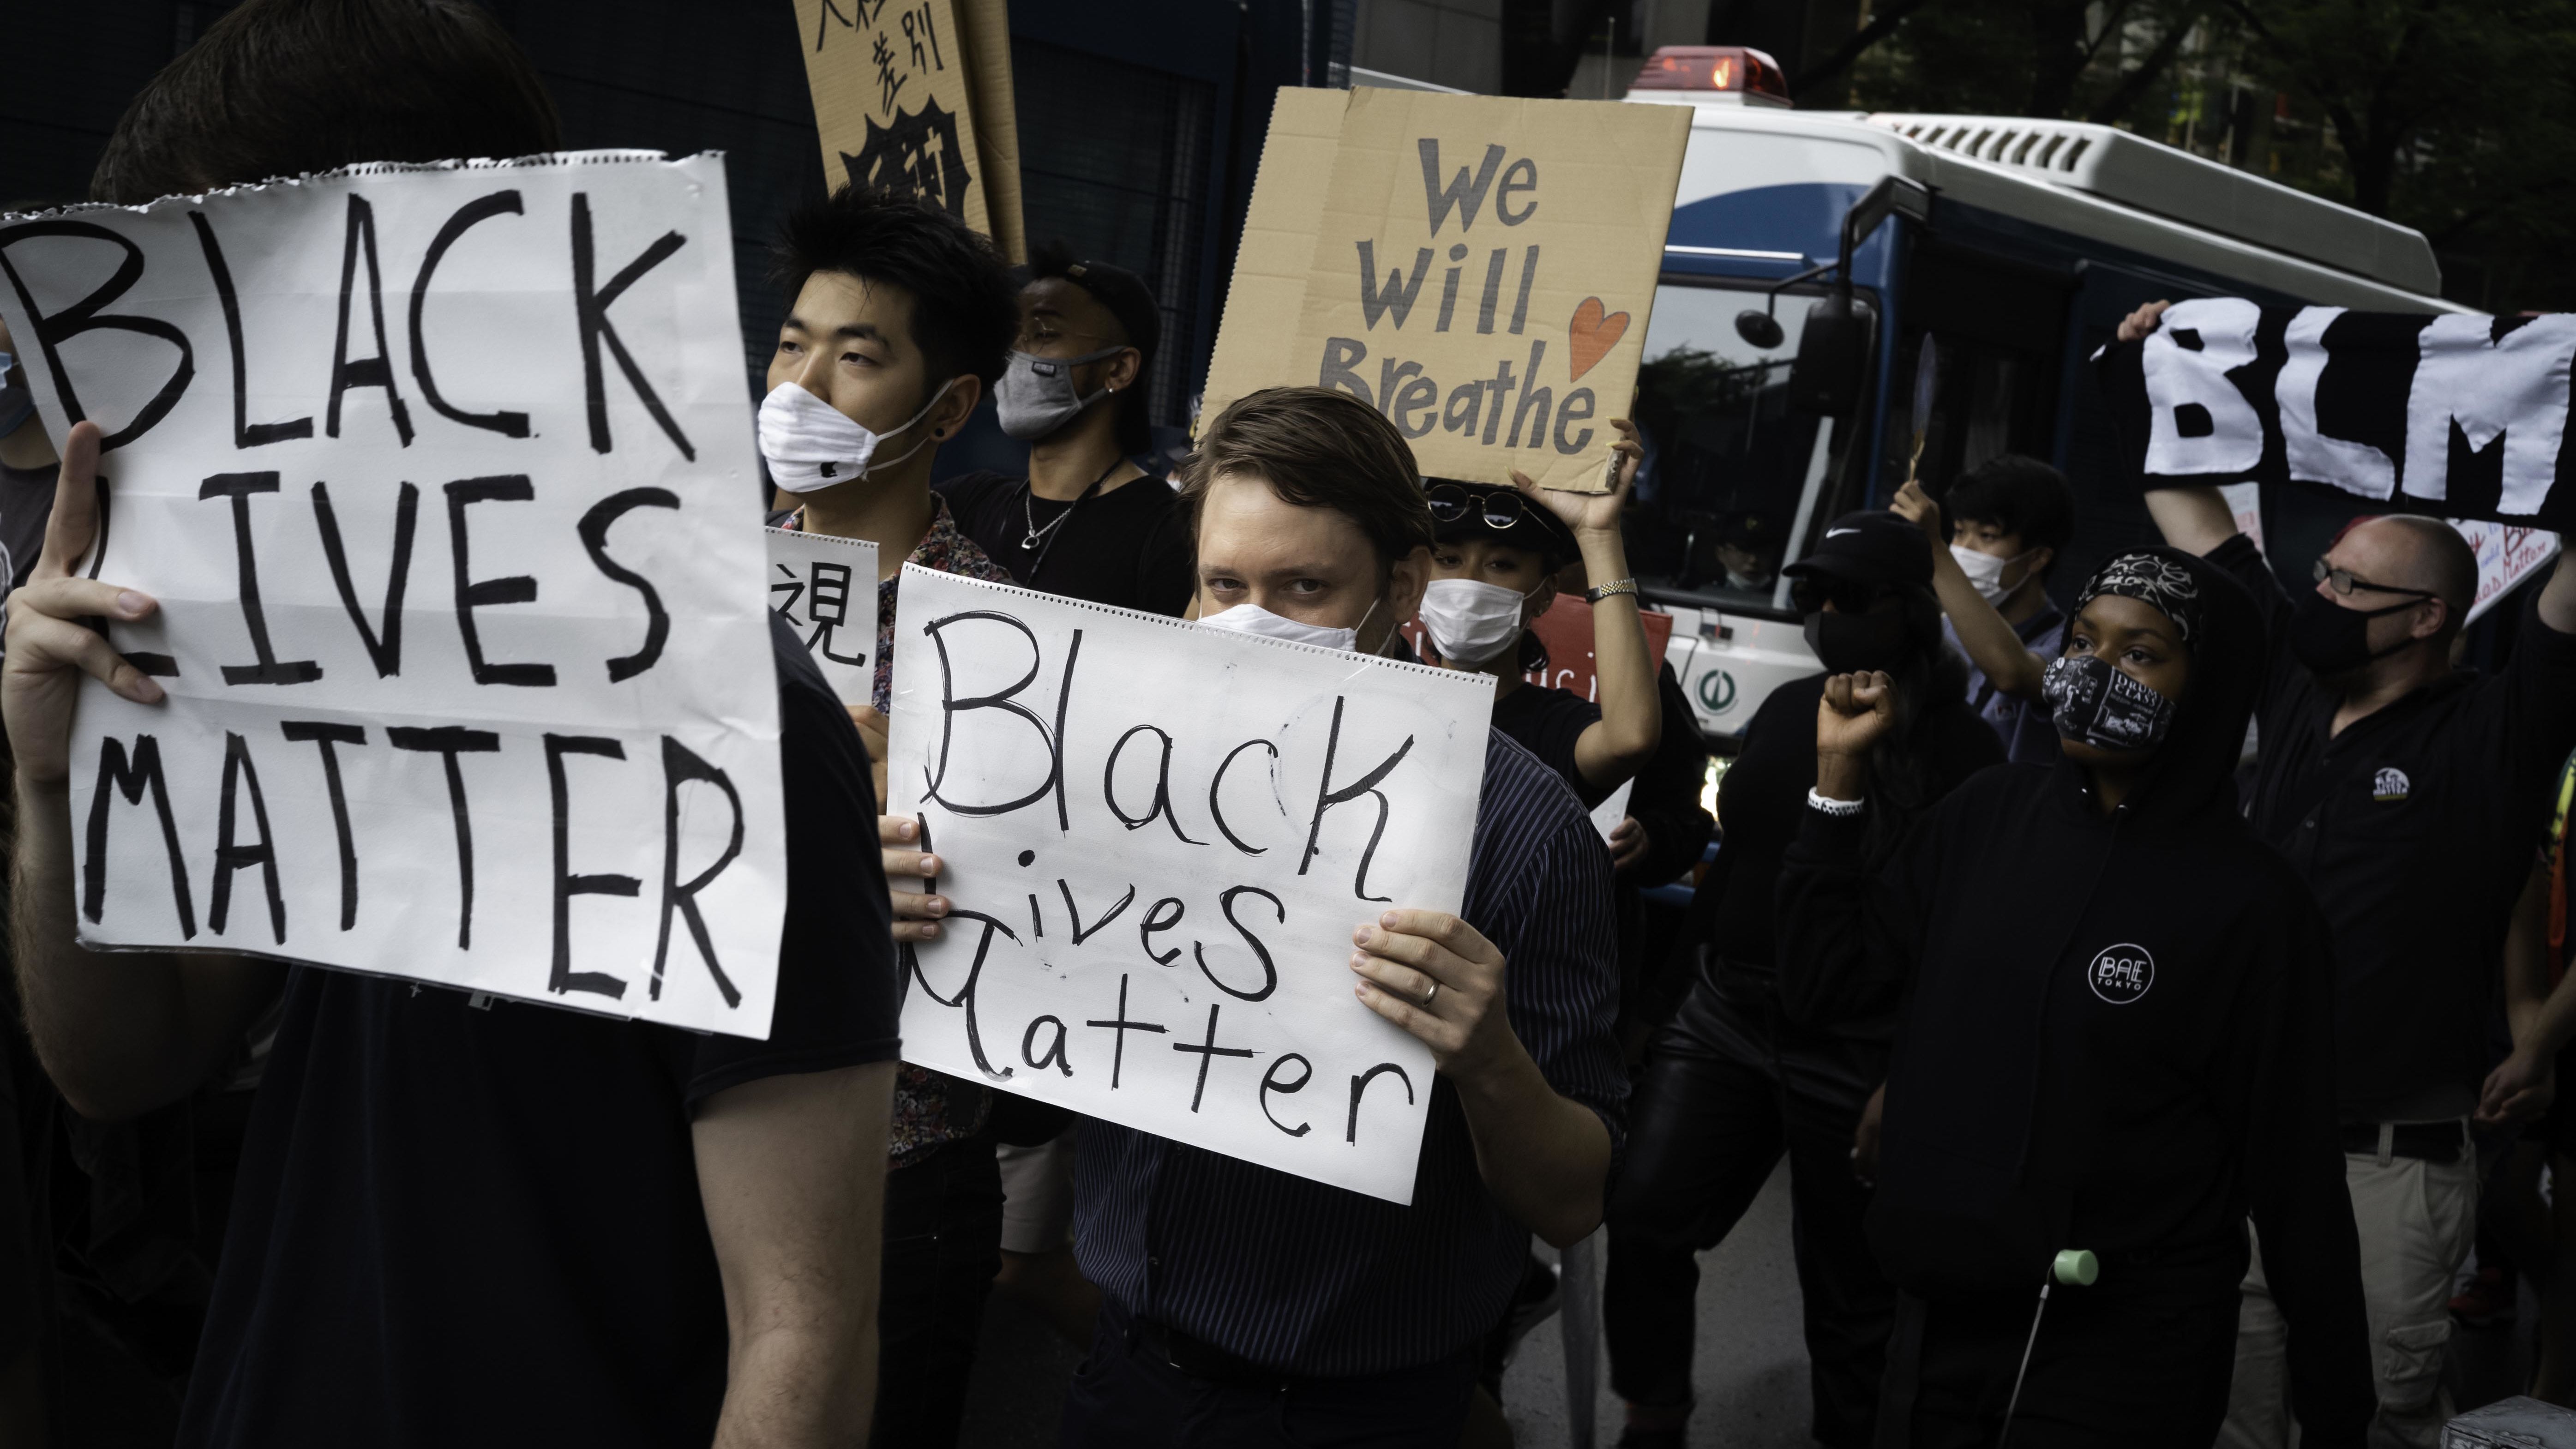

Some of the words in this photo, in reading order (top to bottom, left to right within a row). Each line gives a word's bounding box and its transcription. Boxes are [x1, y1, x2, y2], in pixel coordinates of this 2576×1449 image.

[1418, 138, 1538, 239] We
[0, 190, 695, 461] BLACK
[1355, 239, 1540, 335] Will
[1319, 337, 1596, 454] Breathe
[2142, 296, 2576, 515] BLM
[771, 561, 866, 667] 視
[2115, 684, 2155, 707] CLASS
[919, 610, 1415, 902] Black
[83, 721, 744, 1009] MATTER
[2097, 978, 2141, 991] TOKYO
[2098, 956, 2147, 983] BAE
